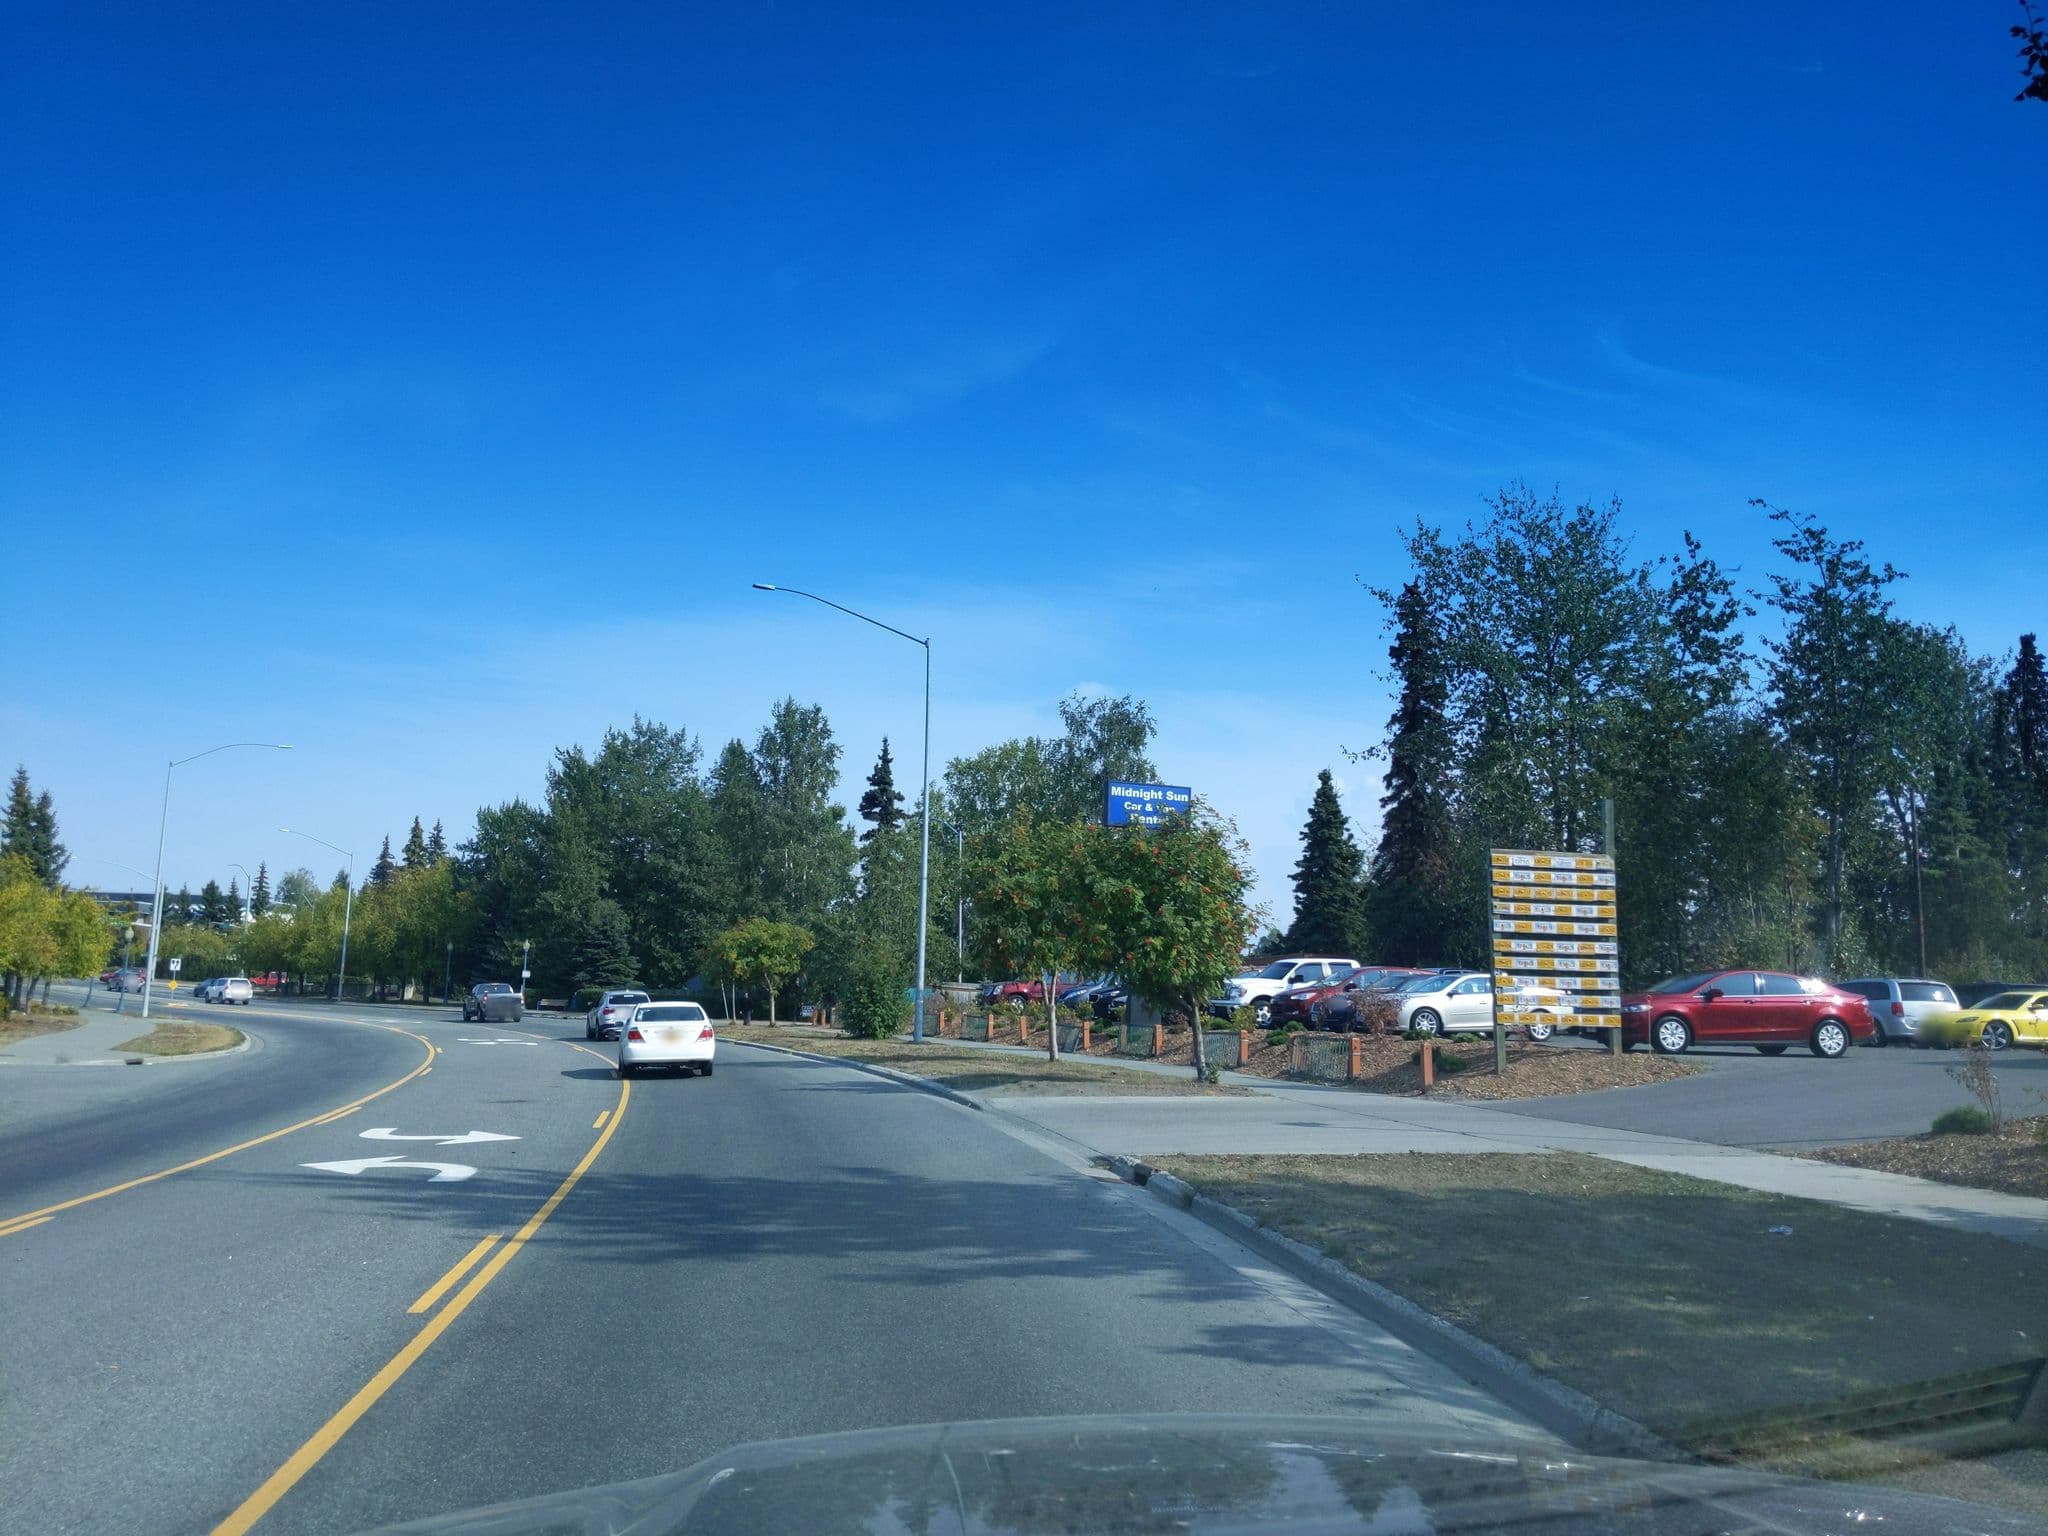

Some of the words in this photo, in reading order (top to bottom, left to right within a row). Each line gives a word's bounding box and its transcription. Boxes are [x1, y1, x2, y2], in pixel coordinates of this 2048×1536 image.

[1111, 786, 1162, 800] Midnight
[1166, 791, 1188, 802] Sun
[1124, 801, 1142, 811] Car
[1145, 803, 1153, 812] &
